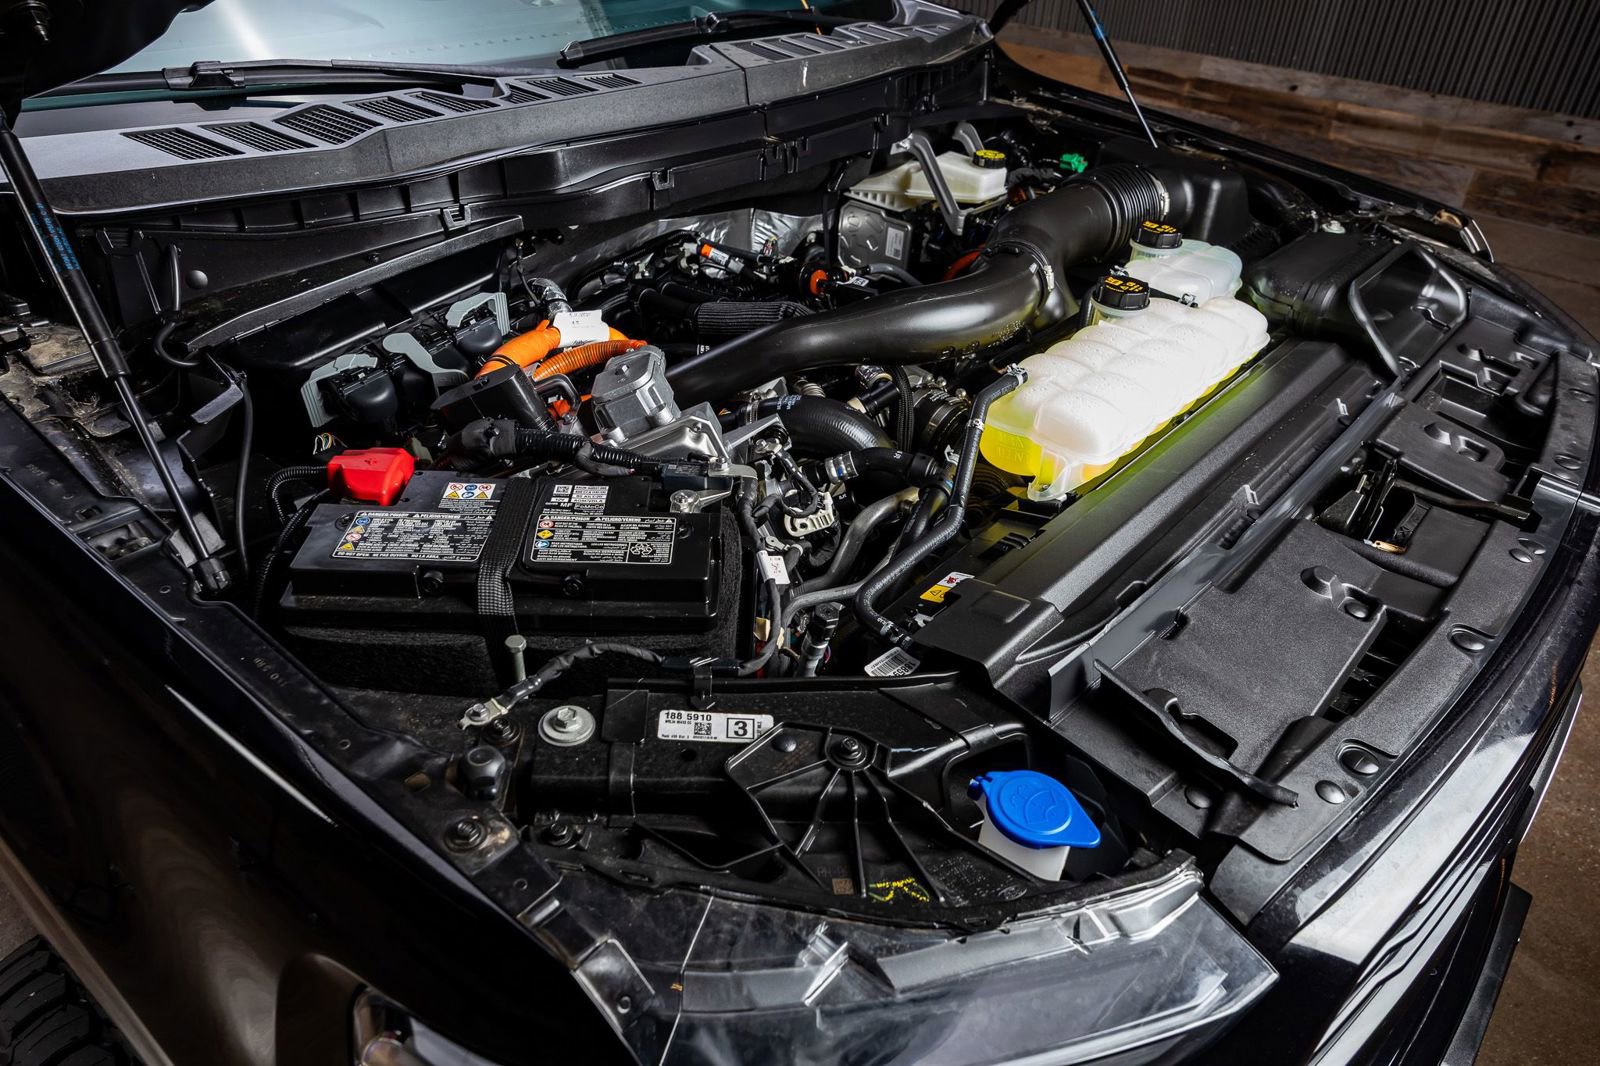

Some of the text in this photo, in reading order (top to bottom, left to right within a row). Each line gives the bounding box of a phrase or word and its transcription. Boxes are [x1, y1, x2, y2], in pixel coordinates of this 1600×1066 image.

[665, 711, 682, 720] 188
[687, 712, 712, 722] 5910
[733, 720, 748, 737] 3
